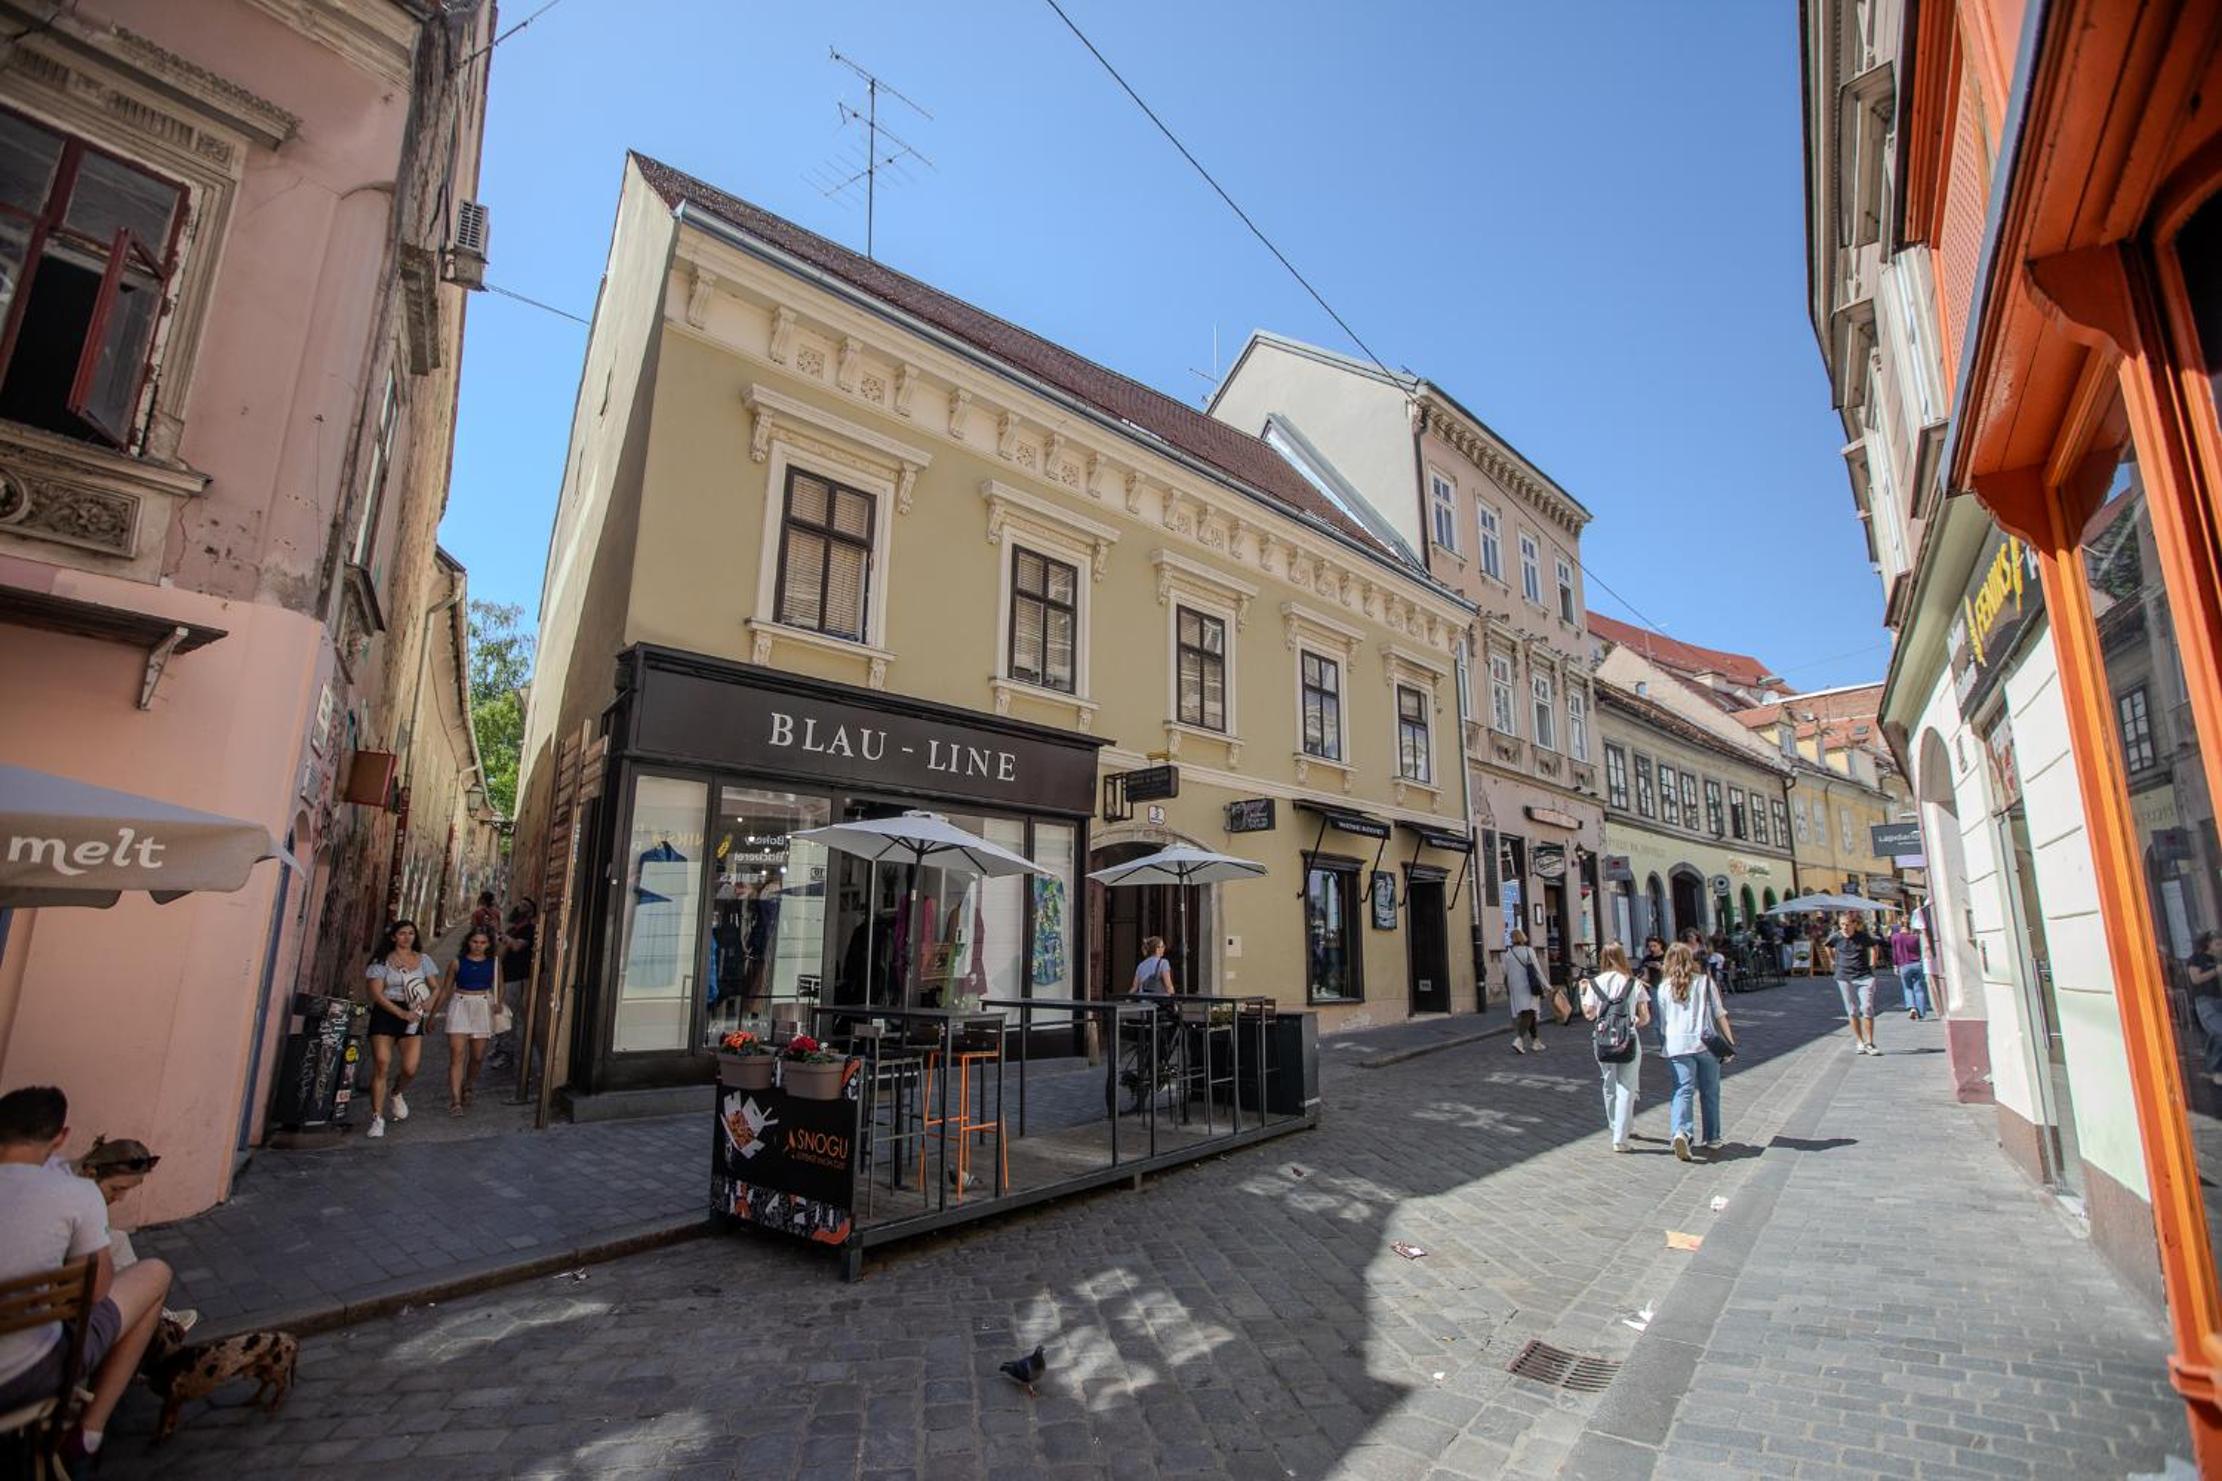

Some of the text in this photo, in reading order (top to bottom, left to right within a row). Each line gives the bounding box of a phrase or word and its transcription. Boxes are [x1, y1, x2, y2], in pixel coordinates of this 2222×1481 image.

[768, 711, 888, 761] BLAU
[927, 739, 1016, 782] LINE
[7, 827, 166, 876] melt
